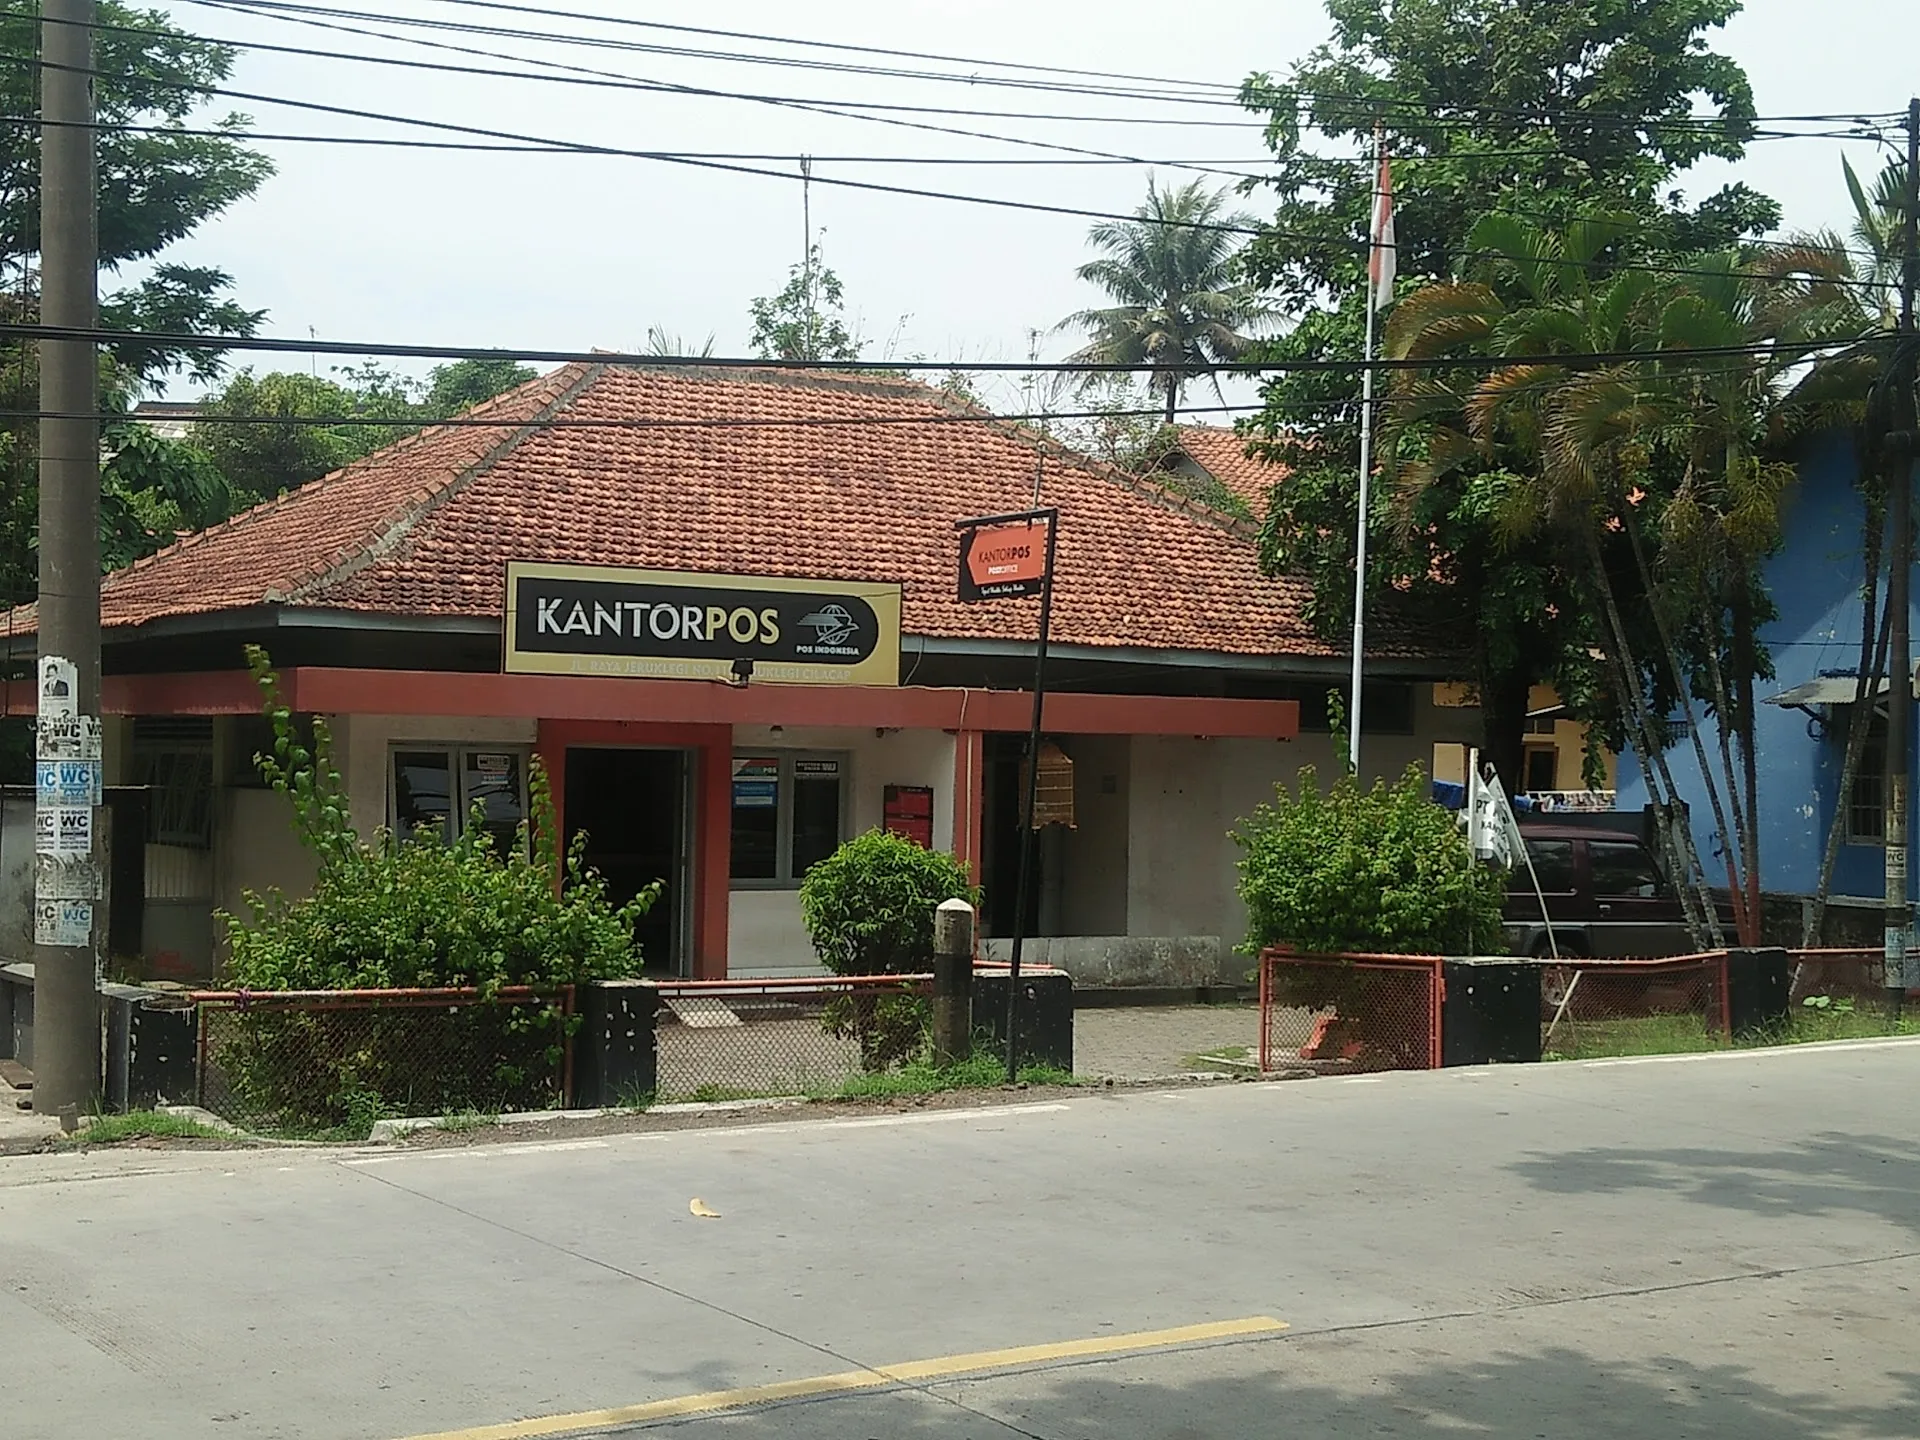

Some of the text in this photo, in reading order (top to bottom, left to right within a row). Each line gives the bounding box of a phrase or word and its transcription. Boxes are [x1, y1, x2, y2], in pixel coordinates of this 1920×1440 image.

[978, 545, 1031, 563] KANTORPOS
[536, 596, 780, 645] KANTORPOS
[796, 645, 860, 656] POS INDONESIA
[590, 660, 620, 672] RAYA
[625, 661, 689, 675] JERUKLEGI
[53, 724, 81, 737] WC
[60, 769, 90, 783] WC
[60, 815, 88, 827] WC
[64, 909, 90, 920] WC
